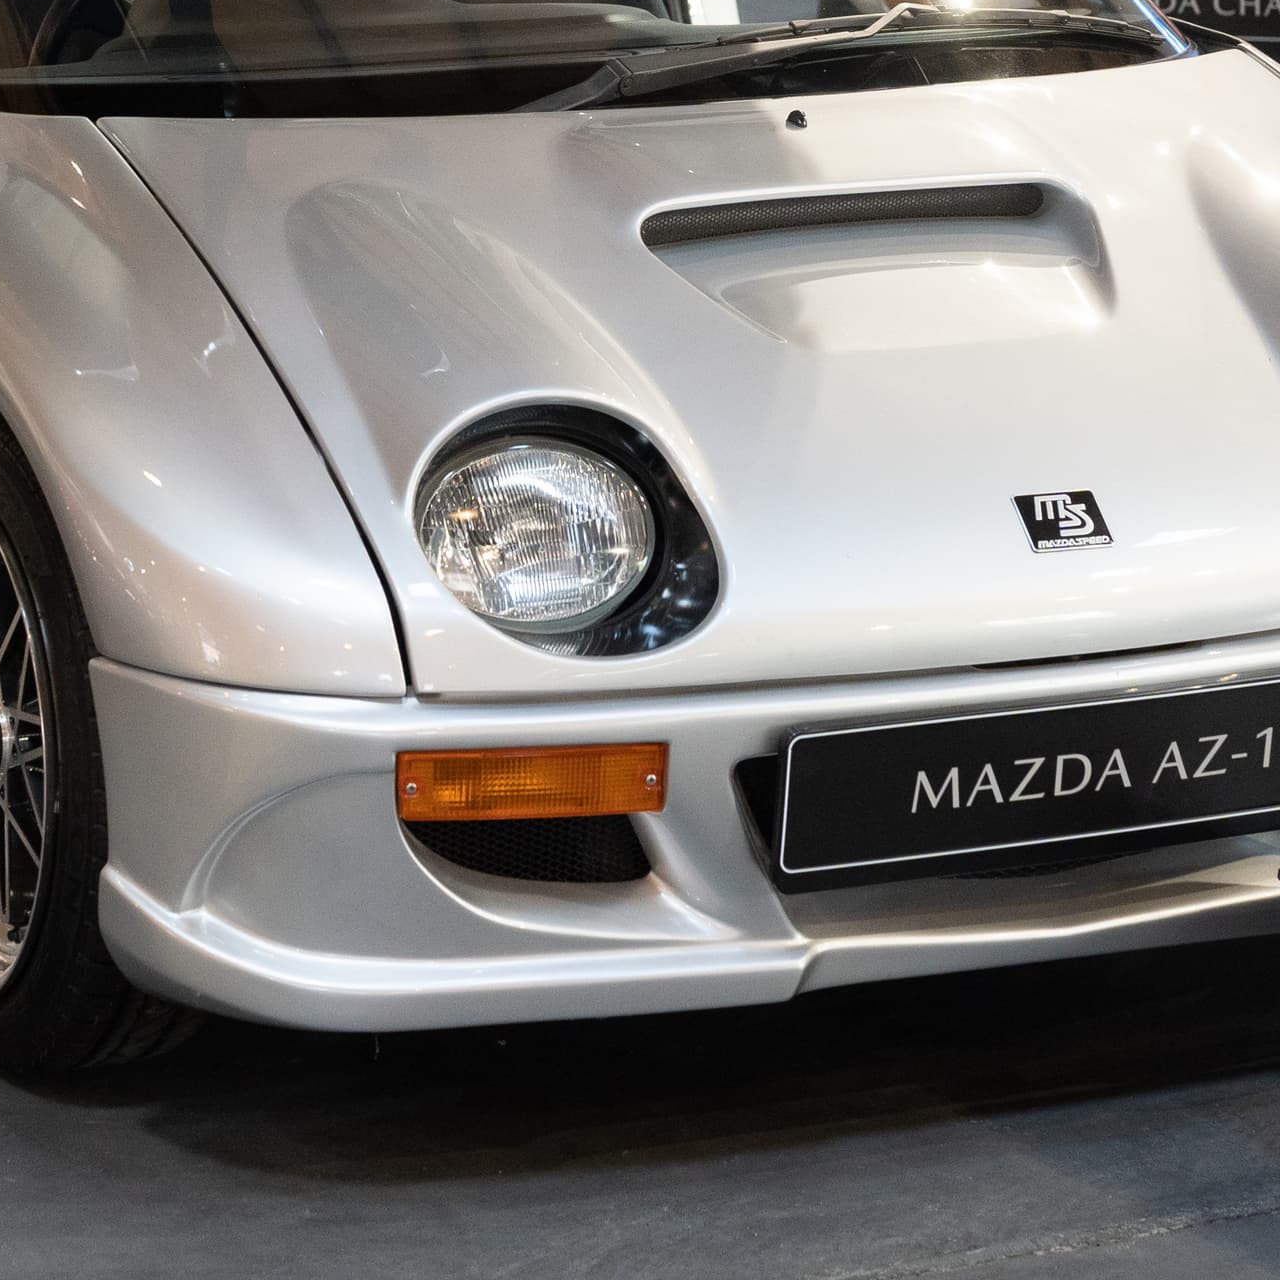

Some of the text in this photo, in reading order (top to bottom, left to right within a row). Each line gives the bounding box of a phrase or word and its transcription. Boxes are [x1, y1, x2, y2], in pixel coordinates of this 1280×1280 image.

[1038, 535, 1110, 549] MAZDASPEED
[911, 726, 1274, 814] MAZDA AZ-1
